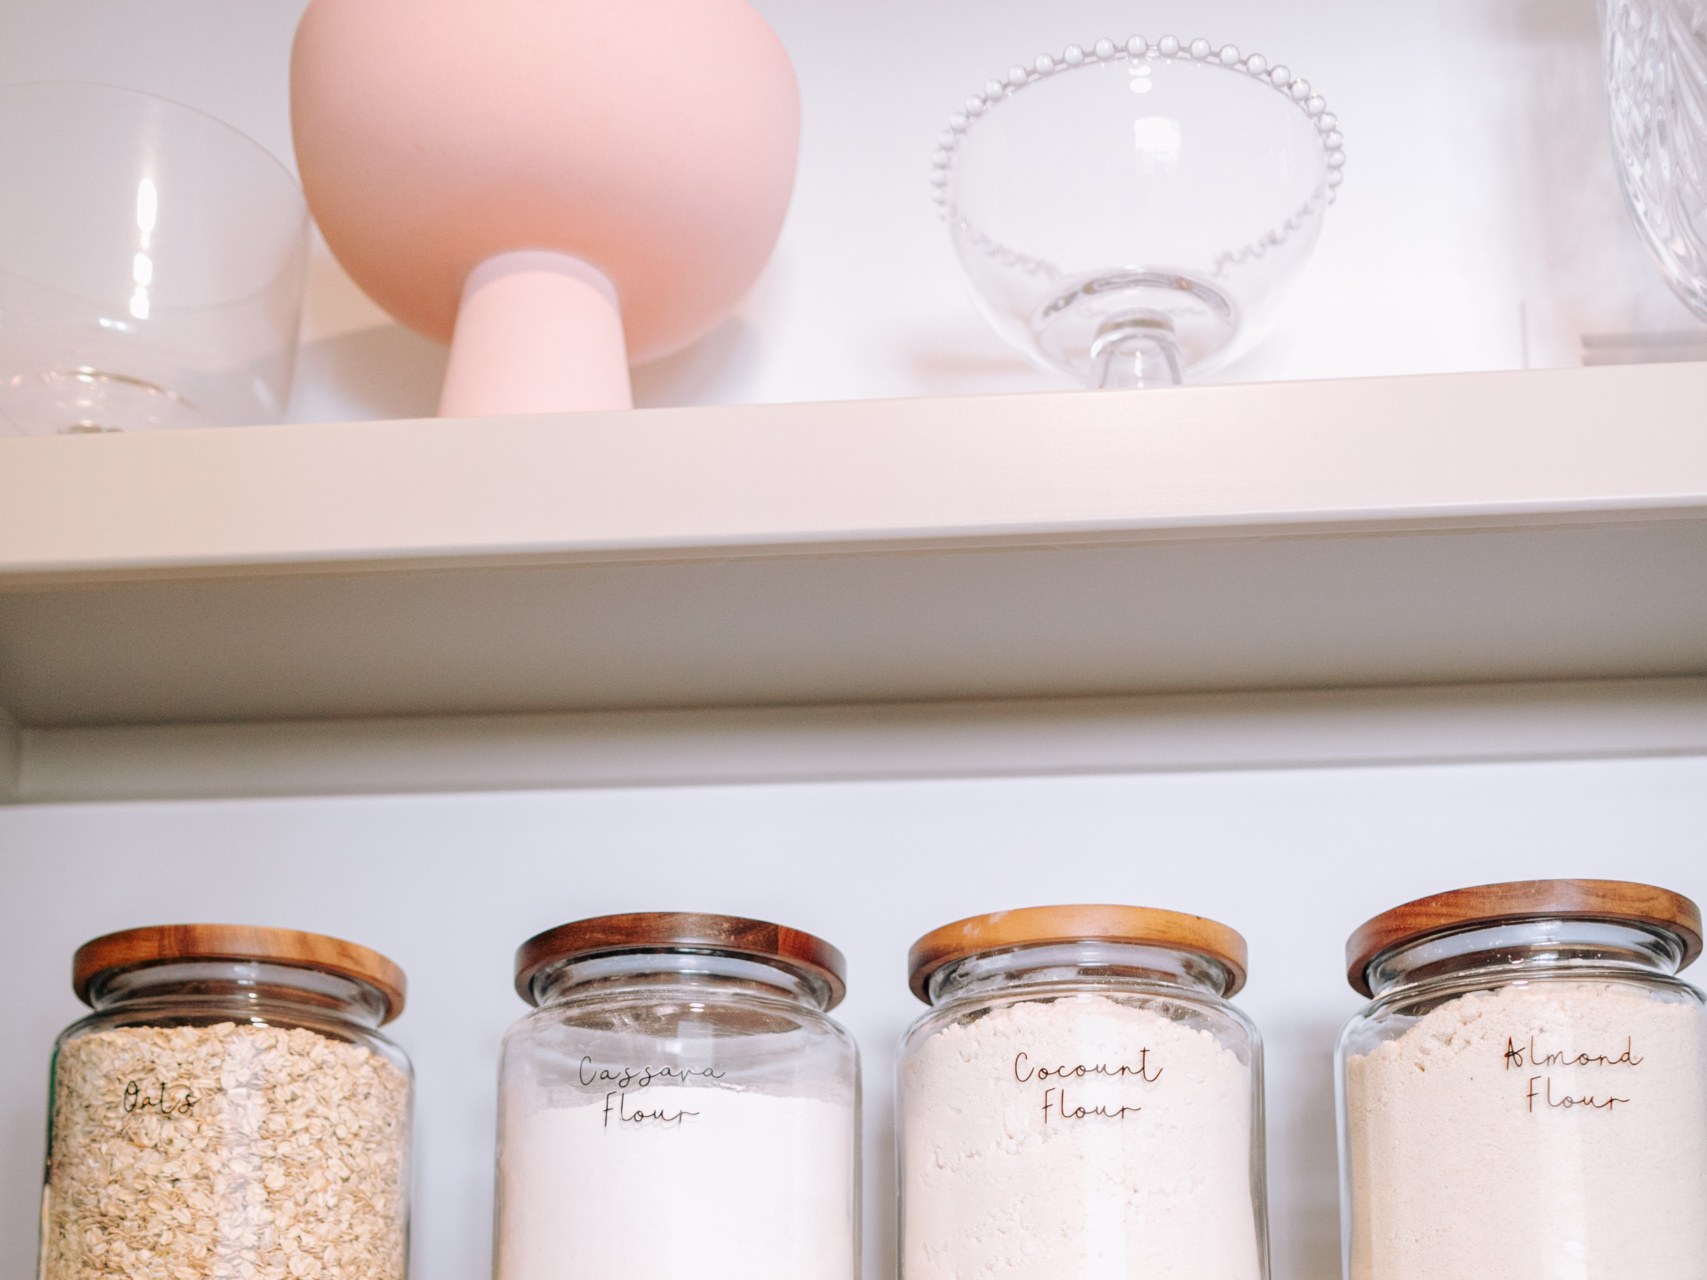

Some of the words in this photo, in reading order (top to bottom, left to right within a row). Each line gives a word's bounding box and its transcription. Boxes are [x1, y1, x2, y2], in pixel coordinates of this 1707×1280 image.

[579, 1055, 726, 1088] Cassava
[1503, 1036, 1644, 1071] Almond
[123, 1080, 201, 1115] Oats
[603, 1091, 700, 1128] Flour
[1042, 1087, 1142, 1124] Flour
[1526, 1075, 1631, 1113] Flour
